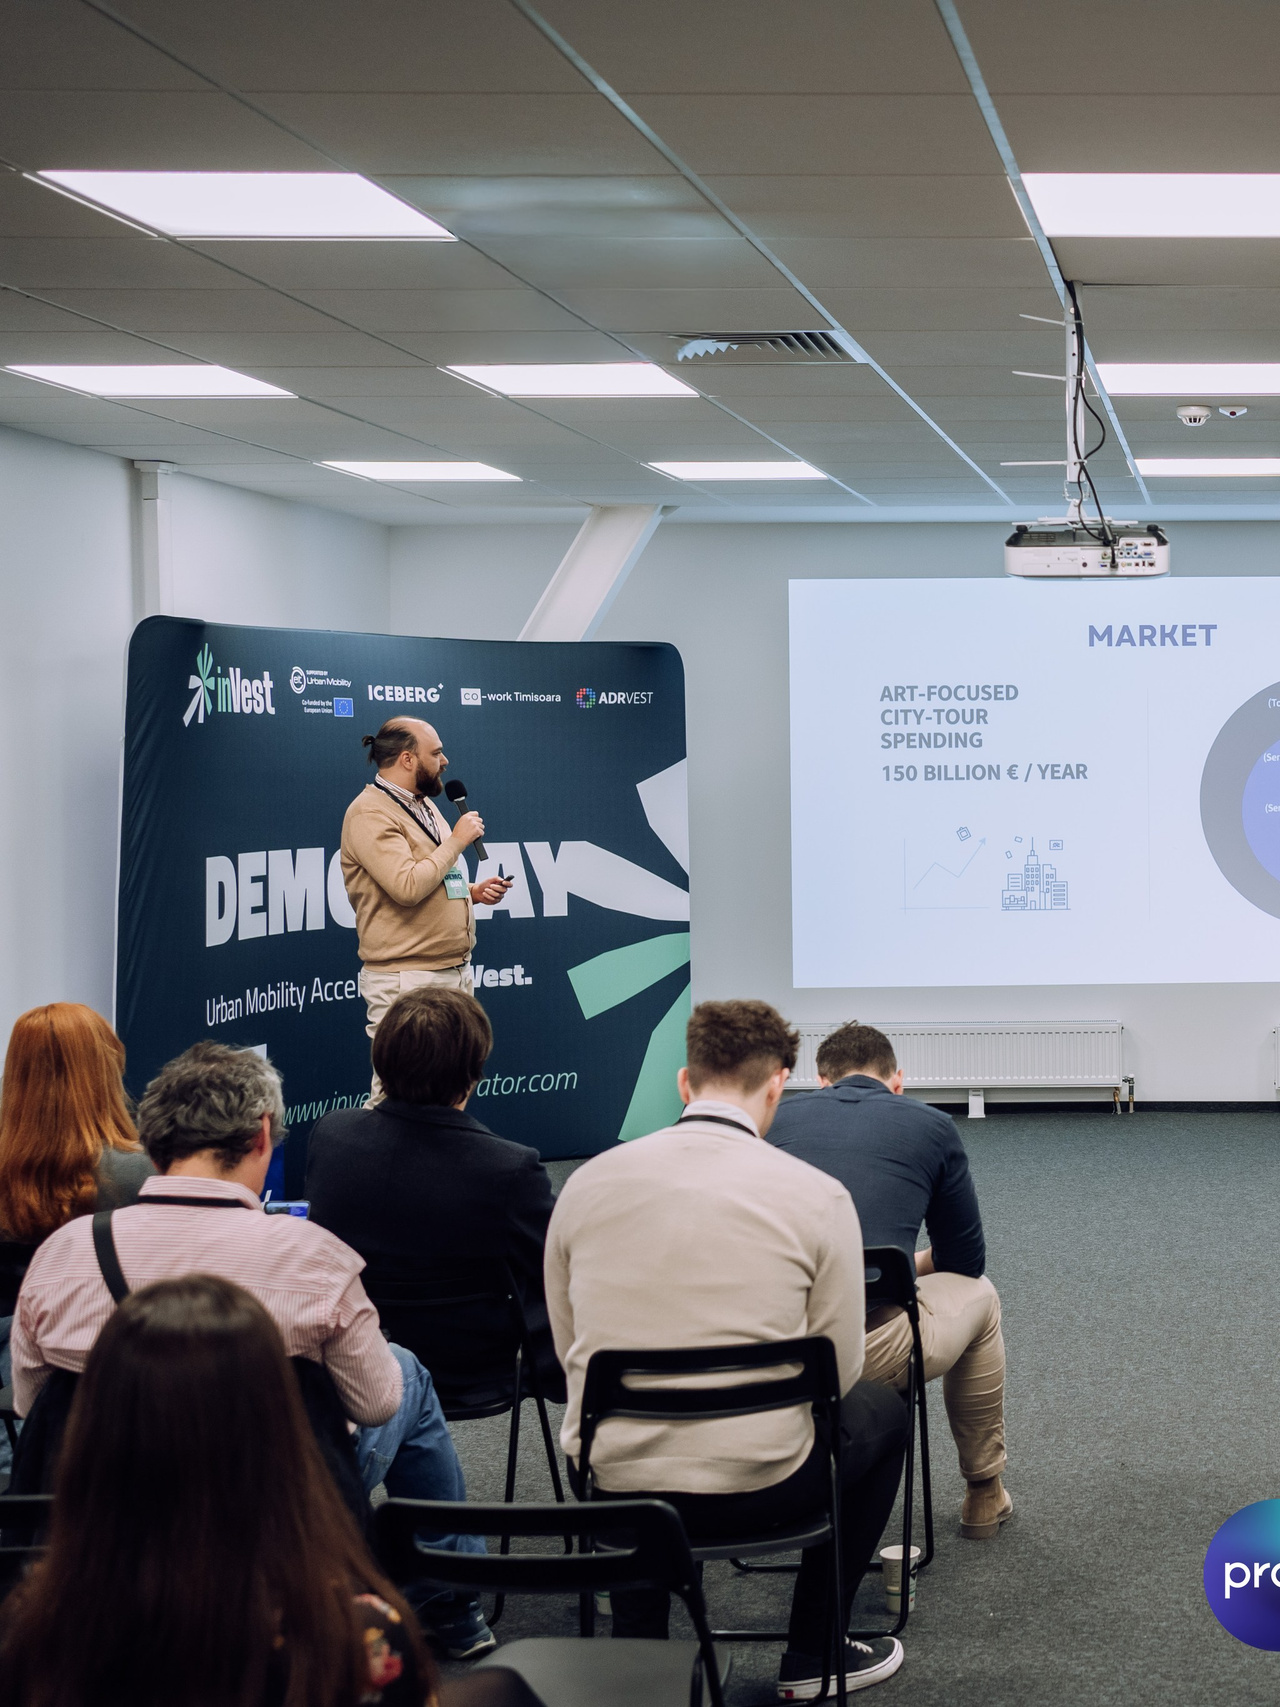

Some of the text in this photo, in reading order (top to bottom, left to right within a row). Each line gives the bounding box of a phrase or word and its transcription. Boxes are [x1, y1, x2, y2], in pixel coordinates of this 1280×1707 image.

[1088, 624, 1217, 648] MARKET
[217, 666, 275, 715] inVest
[307, 677, 351, 688] Urban Mobility
[514, 692, 561, 702] Timisoara
[599, 692, 653, 704] ADRVEST
[880, 685, 1019, 702] ART-FOCUSED
[880, 708, 988, 725] CITY-TOUR
[880, 731, 983, 749] SPENDING
[882, 763, 1088, 782] 150 BILLION € / YEAR
[206, 995, 242, 1027] Urban
[246, 981, 306, 1013] Mobility
[470, 964, 532, 988] Vest.
